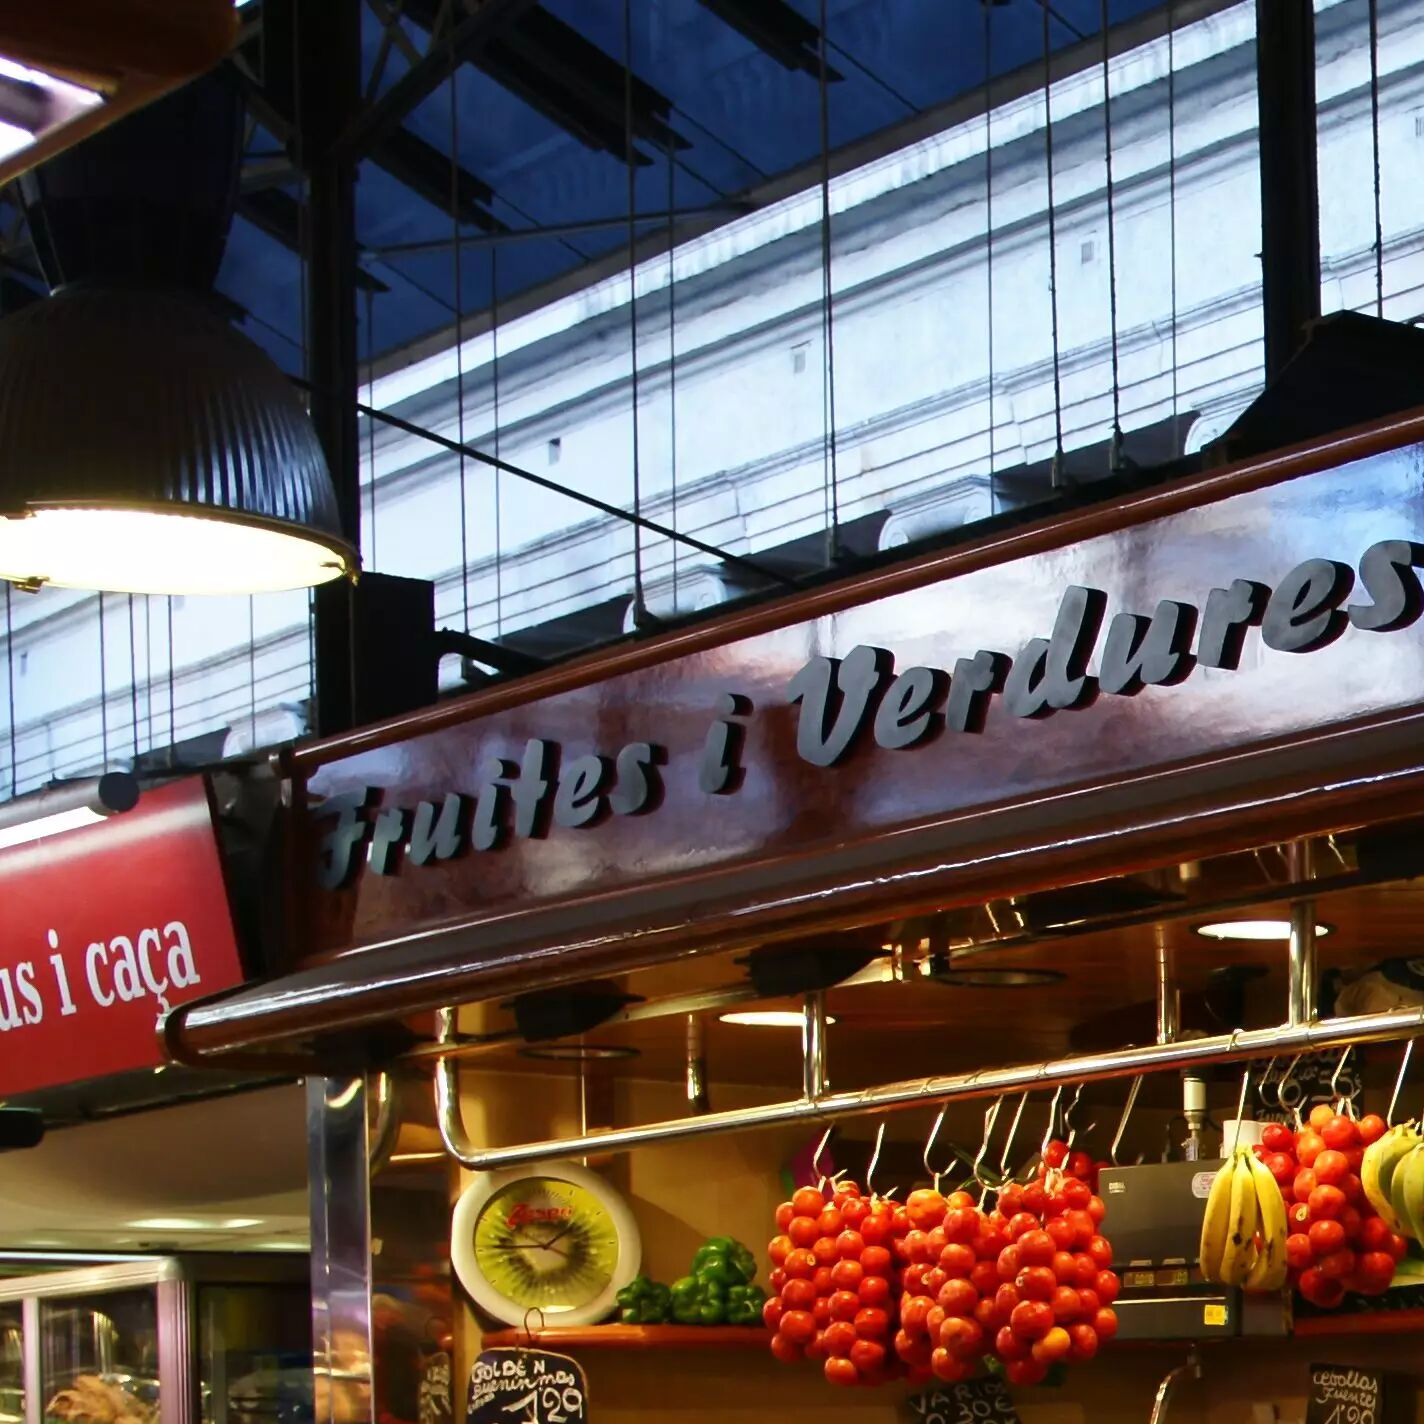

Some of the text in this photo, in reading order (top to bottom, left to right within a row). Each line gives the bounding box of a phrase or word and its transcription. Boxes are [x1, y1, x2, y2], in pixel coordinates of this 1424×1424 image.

[318, 739, 665, 889] Fruites
[700, 692, 753, 795] i
[48, 929, 77, 1016] i
[86, 921, 201, 1020] caça
